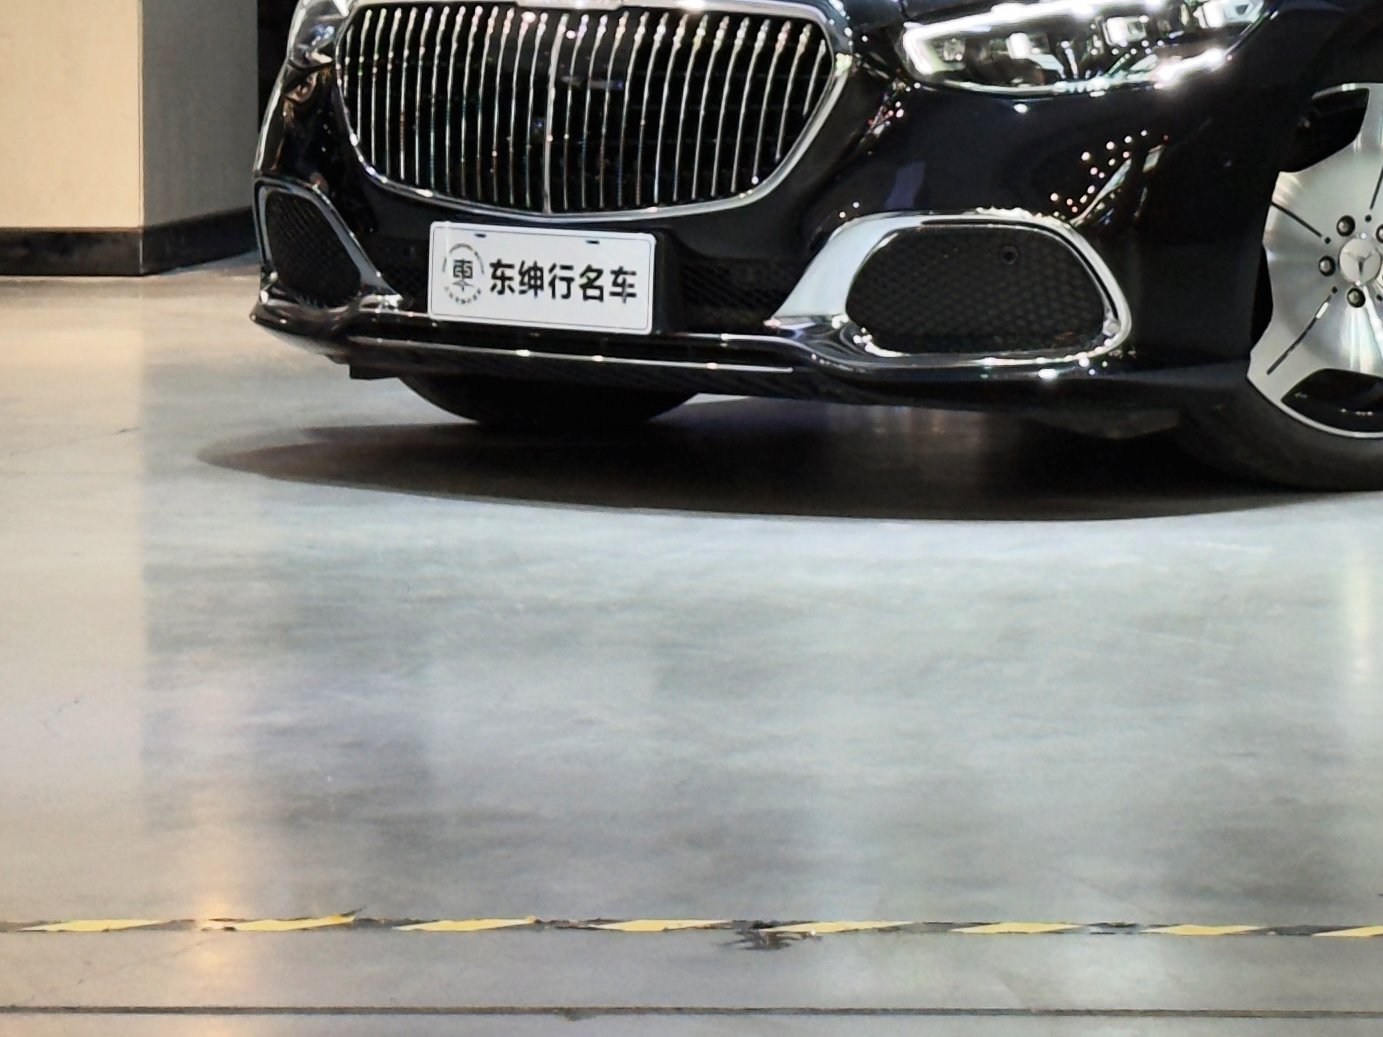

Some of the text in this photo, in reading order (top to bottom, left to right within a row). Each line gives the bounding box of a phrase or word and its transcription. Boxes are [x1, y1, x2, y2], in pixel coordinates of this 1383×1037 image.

[489, 258, 638, 304] 东绅行名车
